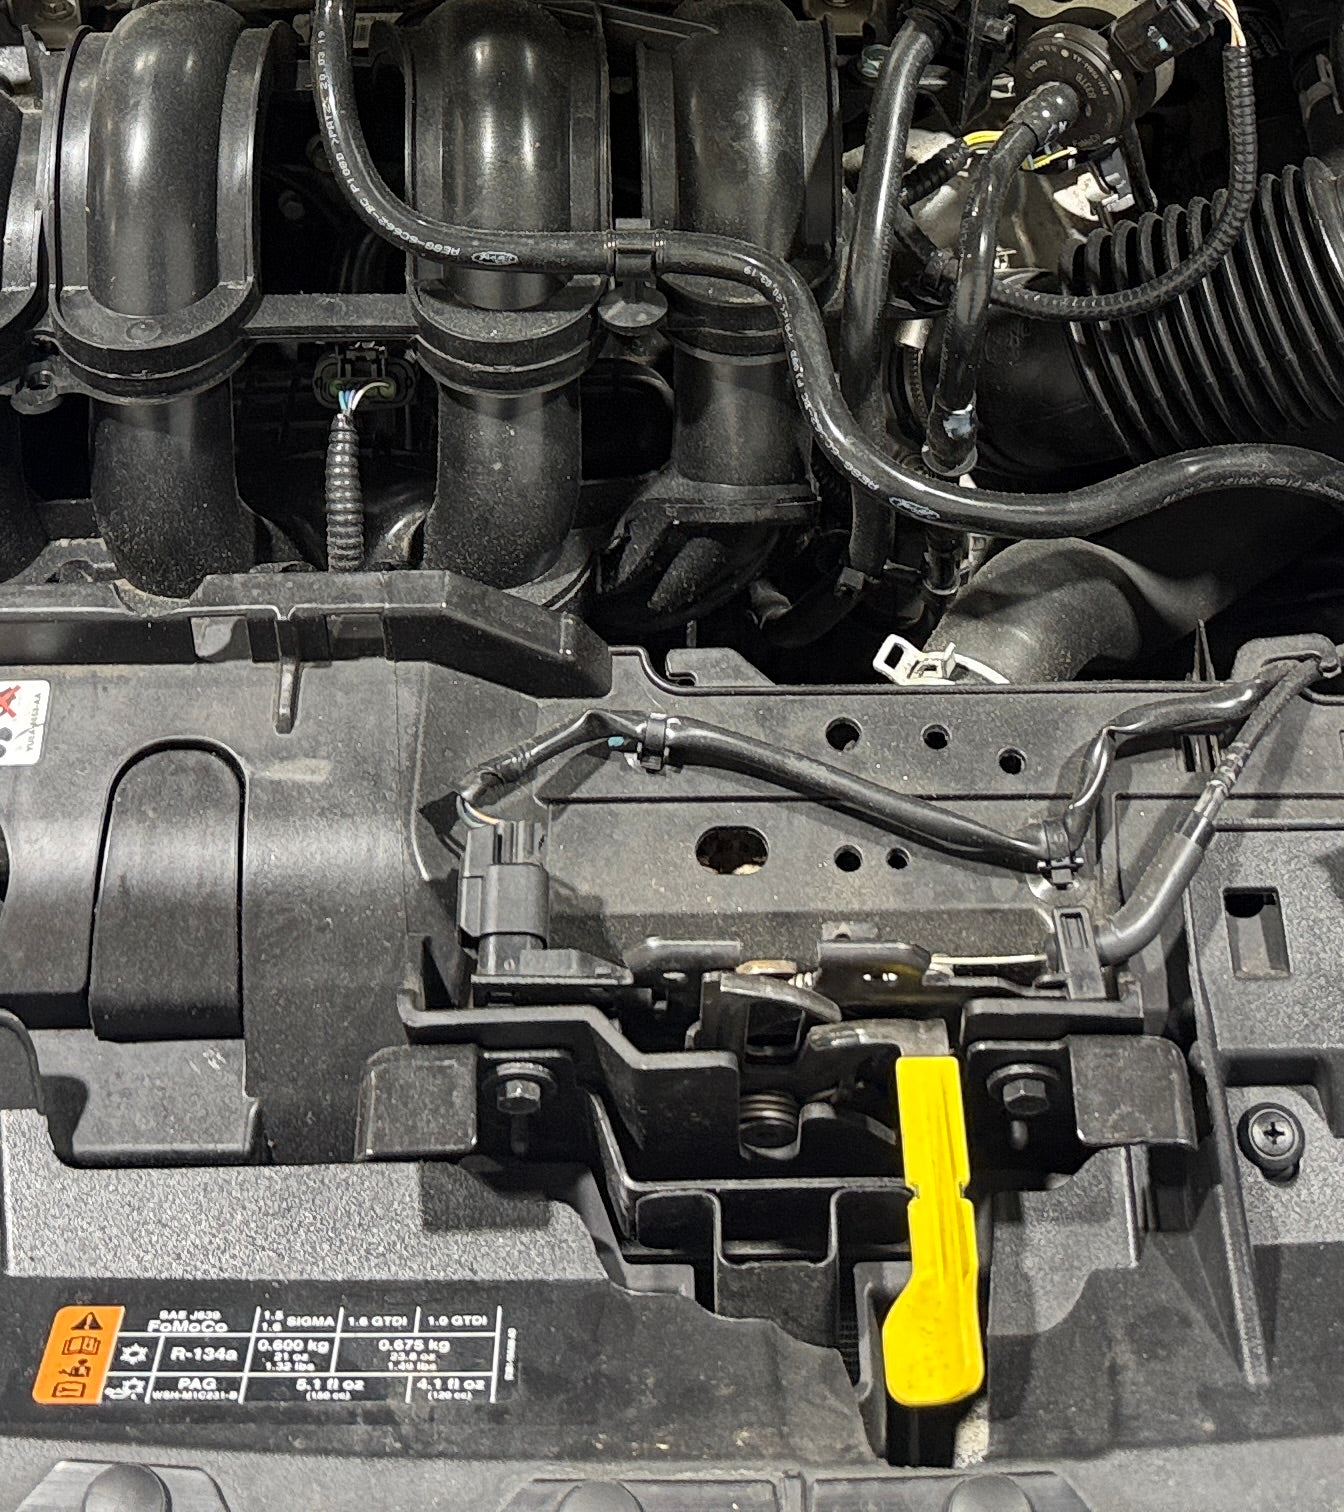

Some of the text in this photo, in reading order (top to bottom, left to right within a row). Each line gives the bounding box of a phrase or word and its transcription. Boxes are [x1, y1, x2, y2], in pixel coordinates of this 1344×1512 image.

[159, 1310, 187, 1320] SAE
[451, 1315, 488, 1326] GTDI
[147, 1319, 229, 1333] FoMoCo
[261, 1321, 282, 1332] 1.6
[286, 1316, 335, 1327] SIGMA
[371, 1316, 408, 1327] GTDI
[257, 1339, 330, 1354] 0.600 kg
[378, 1339, 451, 1354] 0.675 kg
[170, 1346, 238, 1361] R-134a
[177, 1378, 217, 1390] PAG
[296, 1378, 365, 1391] 5.1 fl oz
[416, 1378, 486, 1390] 4.1 fl oz
